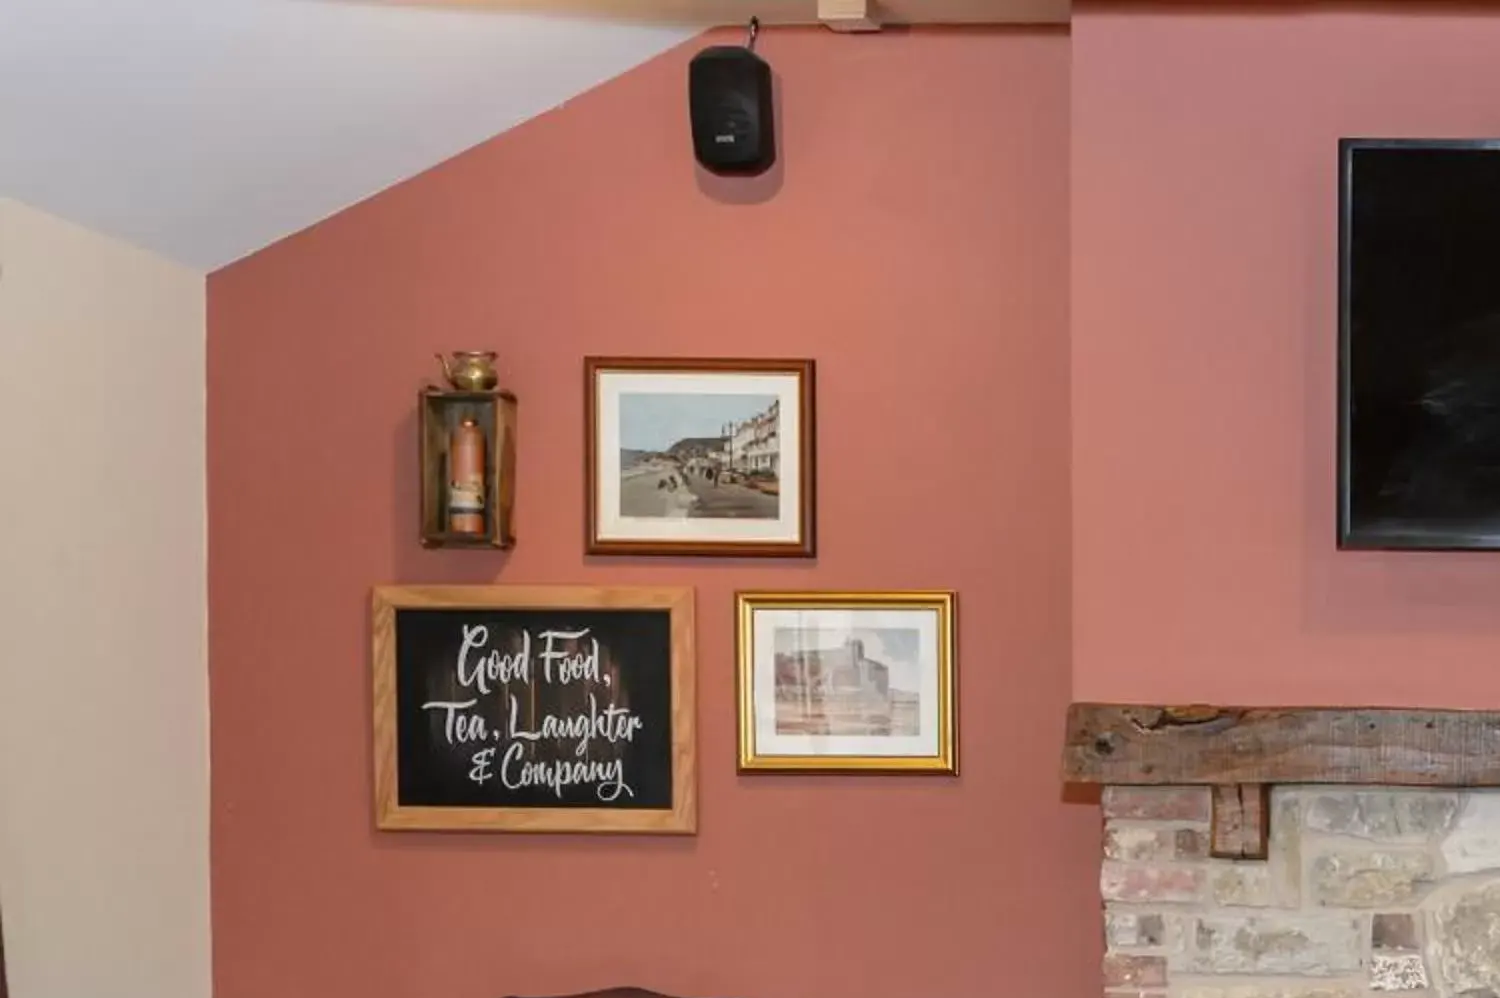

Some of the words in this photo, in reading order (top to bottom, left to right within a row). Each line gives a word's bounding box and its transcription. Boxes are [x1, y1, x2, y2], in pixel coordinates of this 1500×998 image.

[457, 624, 531, 695] Good
[537, 627, 611, 687] Food,
[509, 692, 643, 756] Laughter
[468, 747, 497, 785] &
[500, 741, 635, 801] Company
